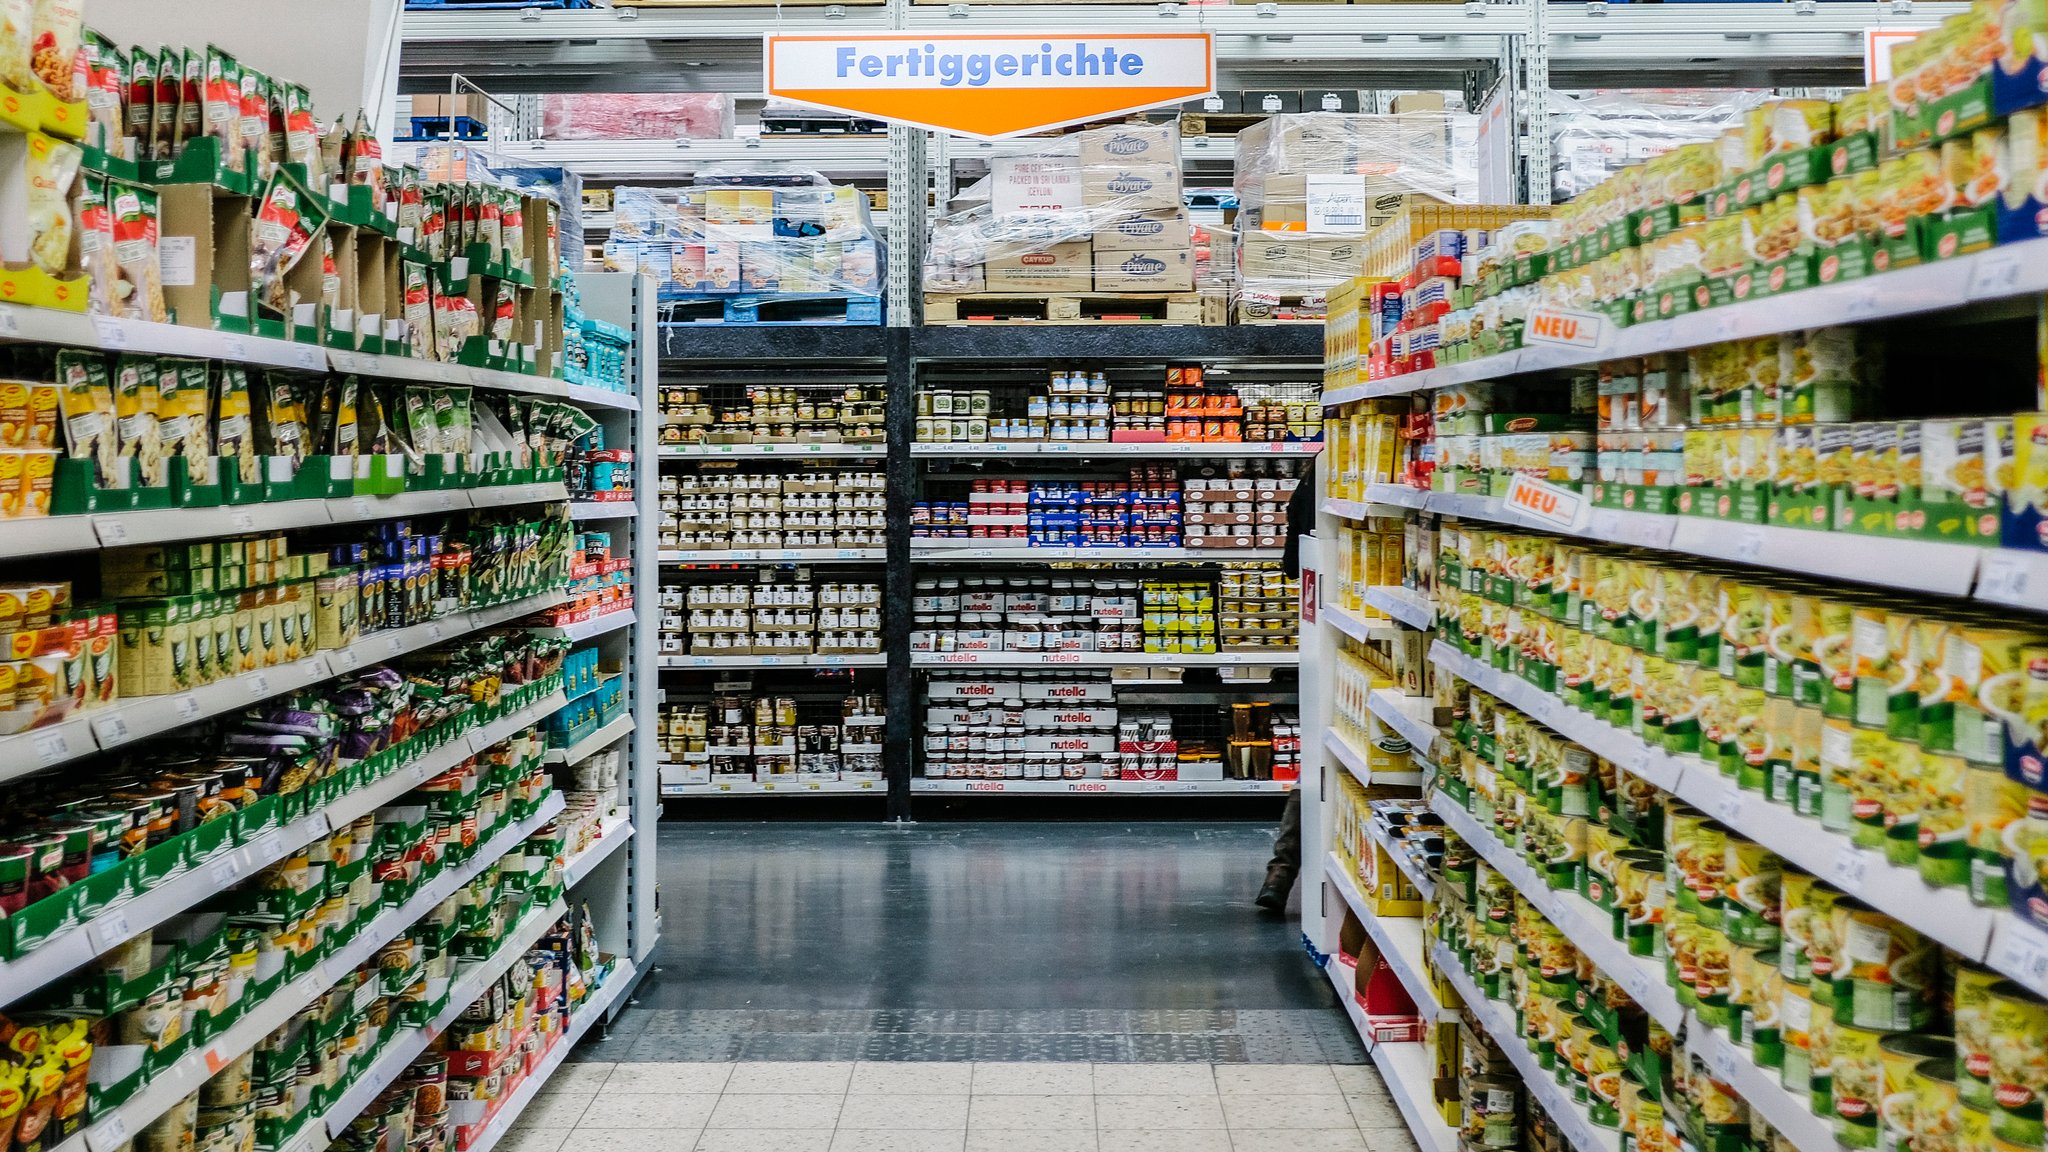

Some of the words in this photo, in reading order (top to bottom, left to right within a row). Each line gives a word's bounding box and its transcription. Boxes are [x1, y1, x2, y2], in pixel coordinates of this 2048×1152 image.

[836, 43, 1144, 87] Fertiggerichte
[1009, 175, 1031, 184] PACKED
[1533, 315, 1578, 340] NEU
[1514, 484, 1558, 514] NEU
[963, 602, 992, 611] nutella
[1007, 602, 1036, 611] nutella
[1093, 607, 1122, 616] nutella
[959, 641, 988, 649] nutella
[940, 653, 977, 662] nutella
[1042, 653, 1079, 662] nutella
[956, 685, 995, 695] nutella
[1048, 686, 1086, 697] nutella
[1053, 713, 1091, 723] nutella
[1050, 739, 1089, 750] nutella
[965, 782, 1004, 791] nutella
[1068, 782, 1107, 792] nutella
